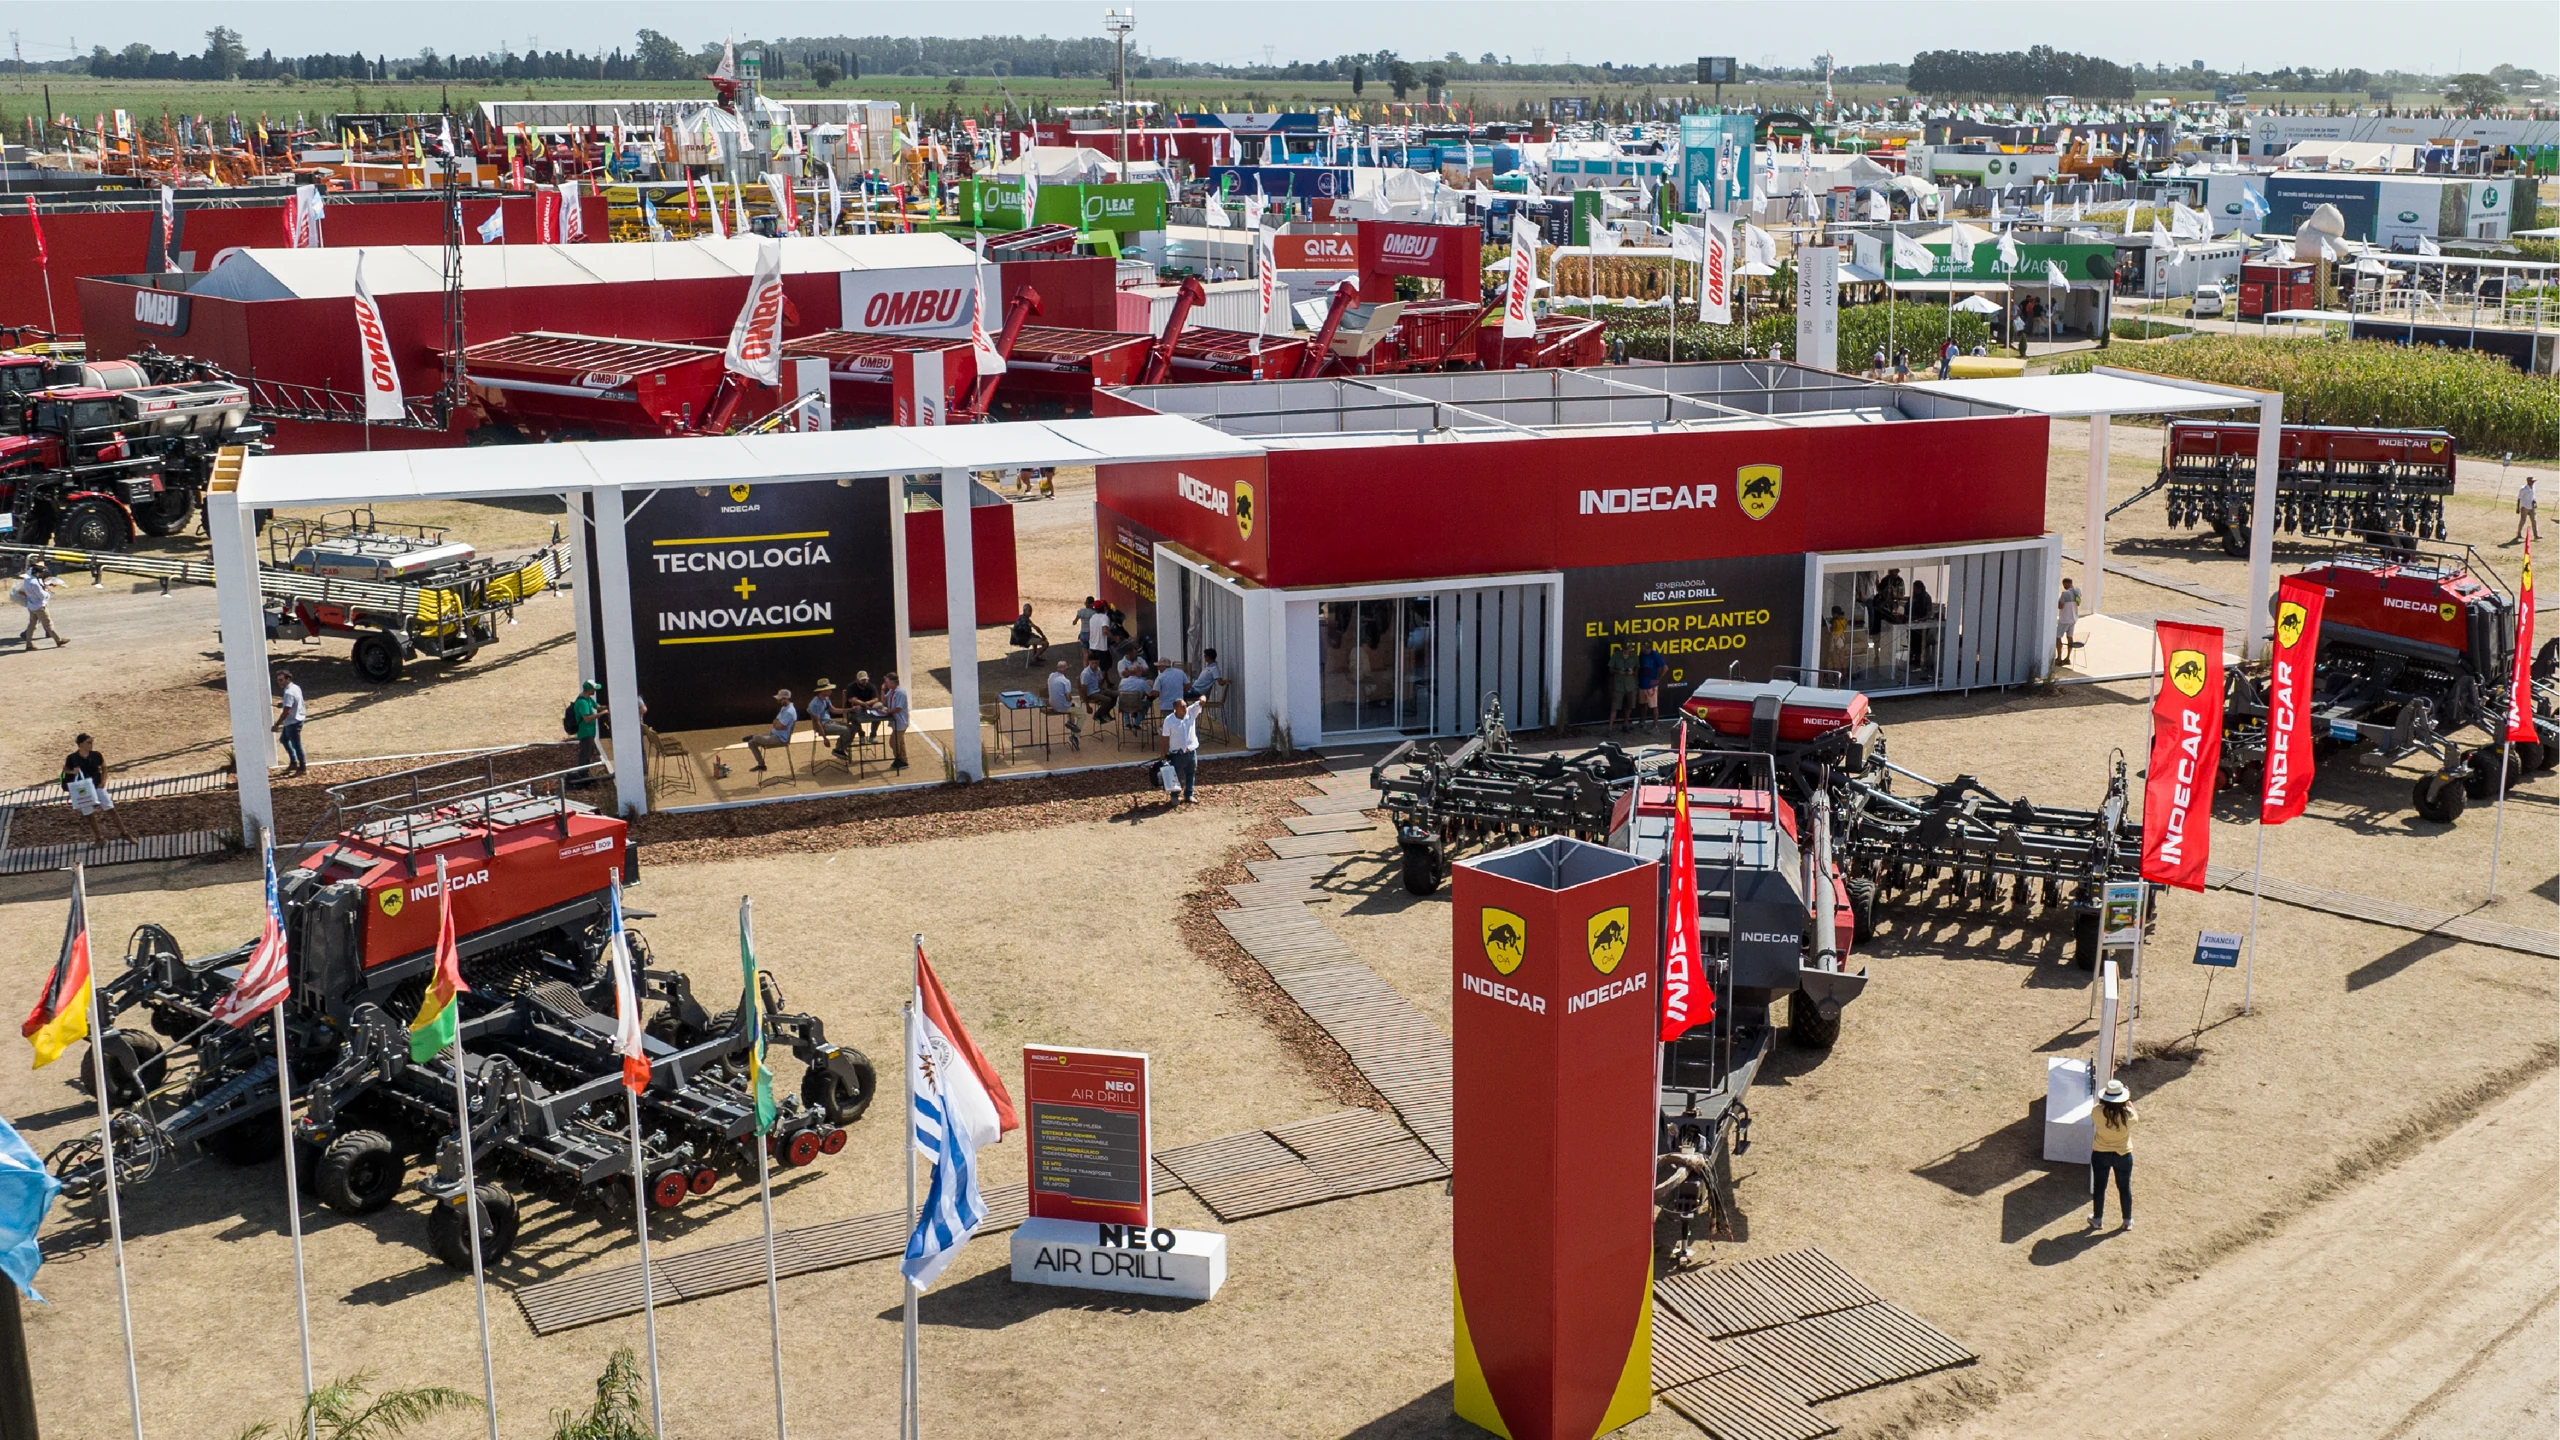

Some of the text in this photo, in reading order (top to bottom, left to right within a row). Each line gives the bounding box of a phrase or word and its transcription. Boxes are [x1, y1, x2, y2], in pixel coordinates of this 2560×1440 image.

[1106, 198, 1134, 212] LEAF
[1304, 240, 1354, 256] QIRA
[1383, 233, 1427, 255] OMBU
[1510, 250, 1530, 320] OMBU
[1708, 239, 1724, 306] OMBU
[135, 290, 178, 326] OMBU
[740, 282, 782, 360] OMBU
[864, 288, 962, 328] OMBU
[356, 298, 395, 392] OMBU
[860, 356, 890, 369] OMBU
[591, 372, 618, 386] OMBU
[720, 504, 760, 513] INDECAR
[1178, 472, 1228, 516] INDECAR
[1580, 484, 1717, 514] INDECAR
[653, 542, 831, 573] TECNOLOGÍA
[1644, 588, 1718, 601] NEO AIR DRILL
[1655, 580, 1706, 590] SEMBRADORA
[659, 600, 832, 631] INNOVACIÓN
[2384, 597, 2438, 614] INDECAR
[1586, 609, 1770, 638] EL MEJOR PLANTEO
[1658, 634, 1747, 654] MERCADO
[1803, 717, 1840, 727] INDECAR
[2266, 660, 2292, 806] INDECAR
[2160, 708, 2200, 866] INDECAR
[1741, 932, 1798, 944] INDECAR
[2204, 936, 2236, 946] FINANCIA
[1462, 972, 1546, 1015] INDECAR
[1568, 972, 1647, 1014] INDECAR
[1072, 1088, 1136, 1104] AIR DRILL
[1105, 1080, 1136, 1092] NEO
[1100, 1223, 1176, 1252] NEO
[1034, 1248, 1176, 1281] AIR DRILL
